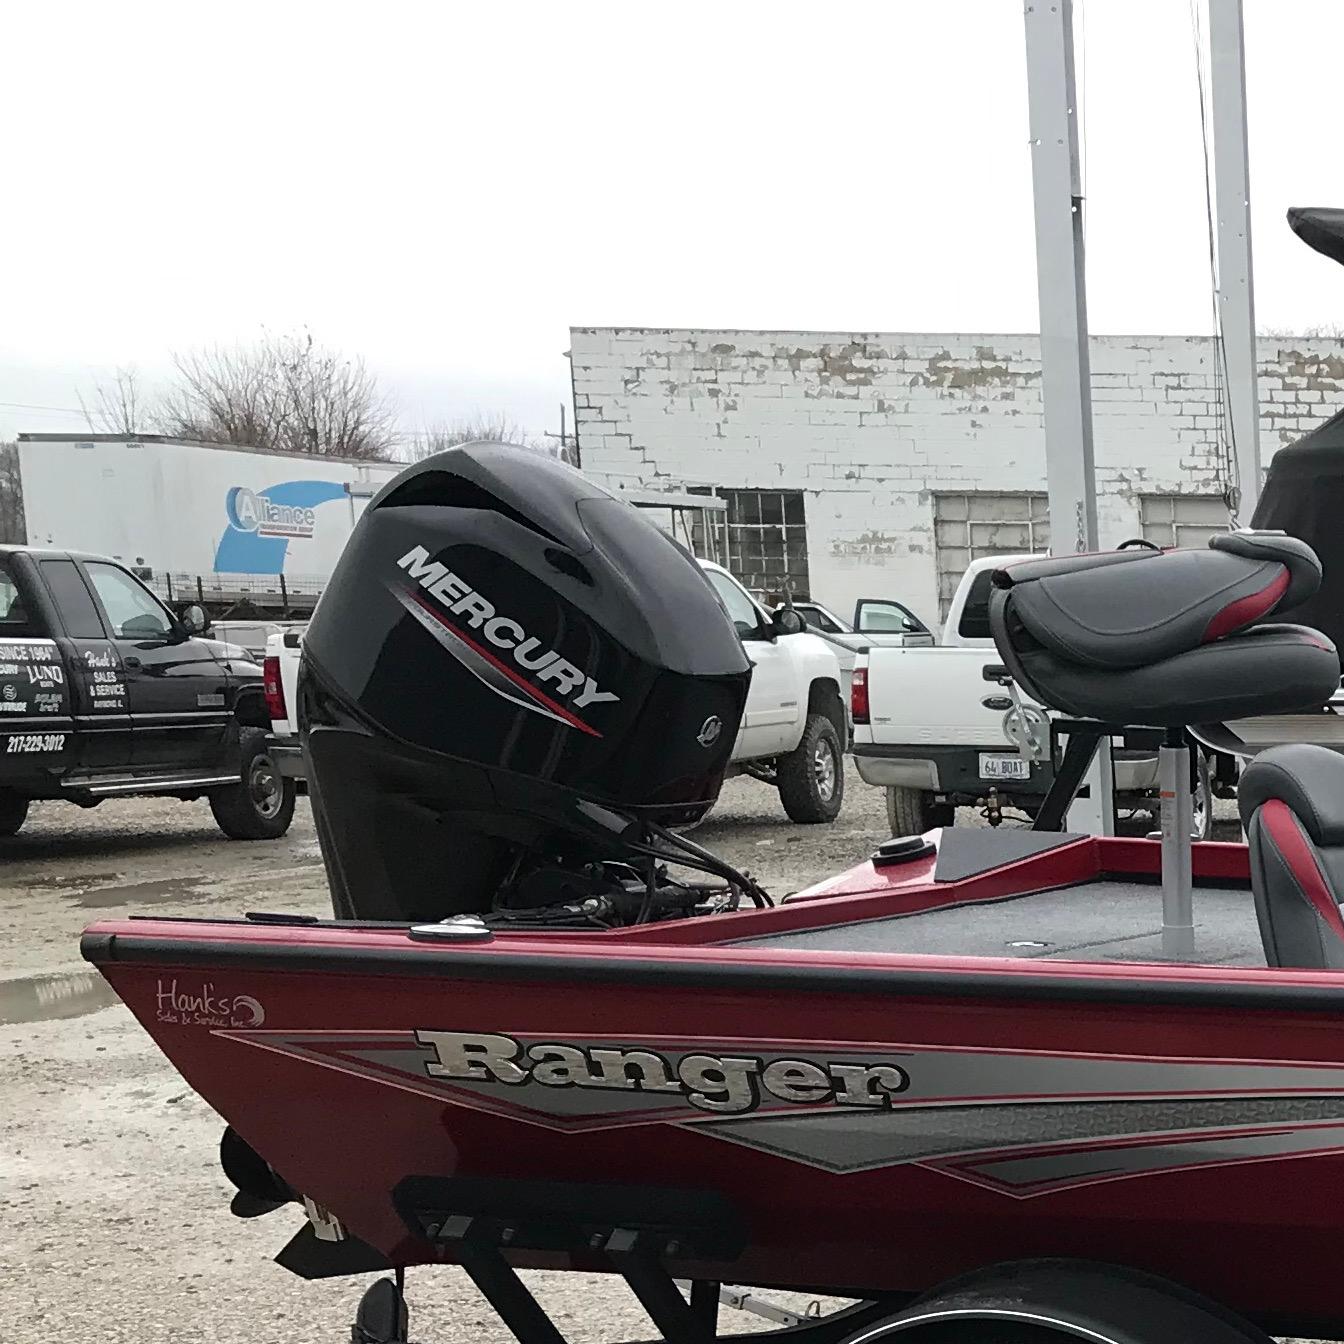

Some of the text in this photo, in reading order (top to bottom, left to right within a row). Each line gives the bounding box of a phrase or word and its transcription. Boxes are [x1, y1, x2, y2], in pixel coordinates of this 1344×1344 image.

[239, 495, 316, 526] Alliance
[396, 544, 621, 708] MERCURY
[26, 665, 64, 684] LUND
[93, 671, 117, 683] SALES
[96, 684, 126, 696] SERVICE
[7, 735, 66, 753] 217-229-3012
[156, 979, 230, 1015] Hank's
[415, 1028, 910, 1114] Ranger
